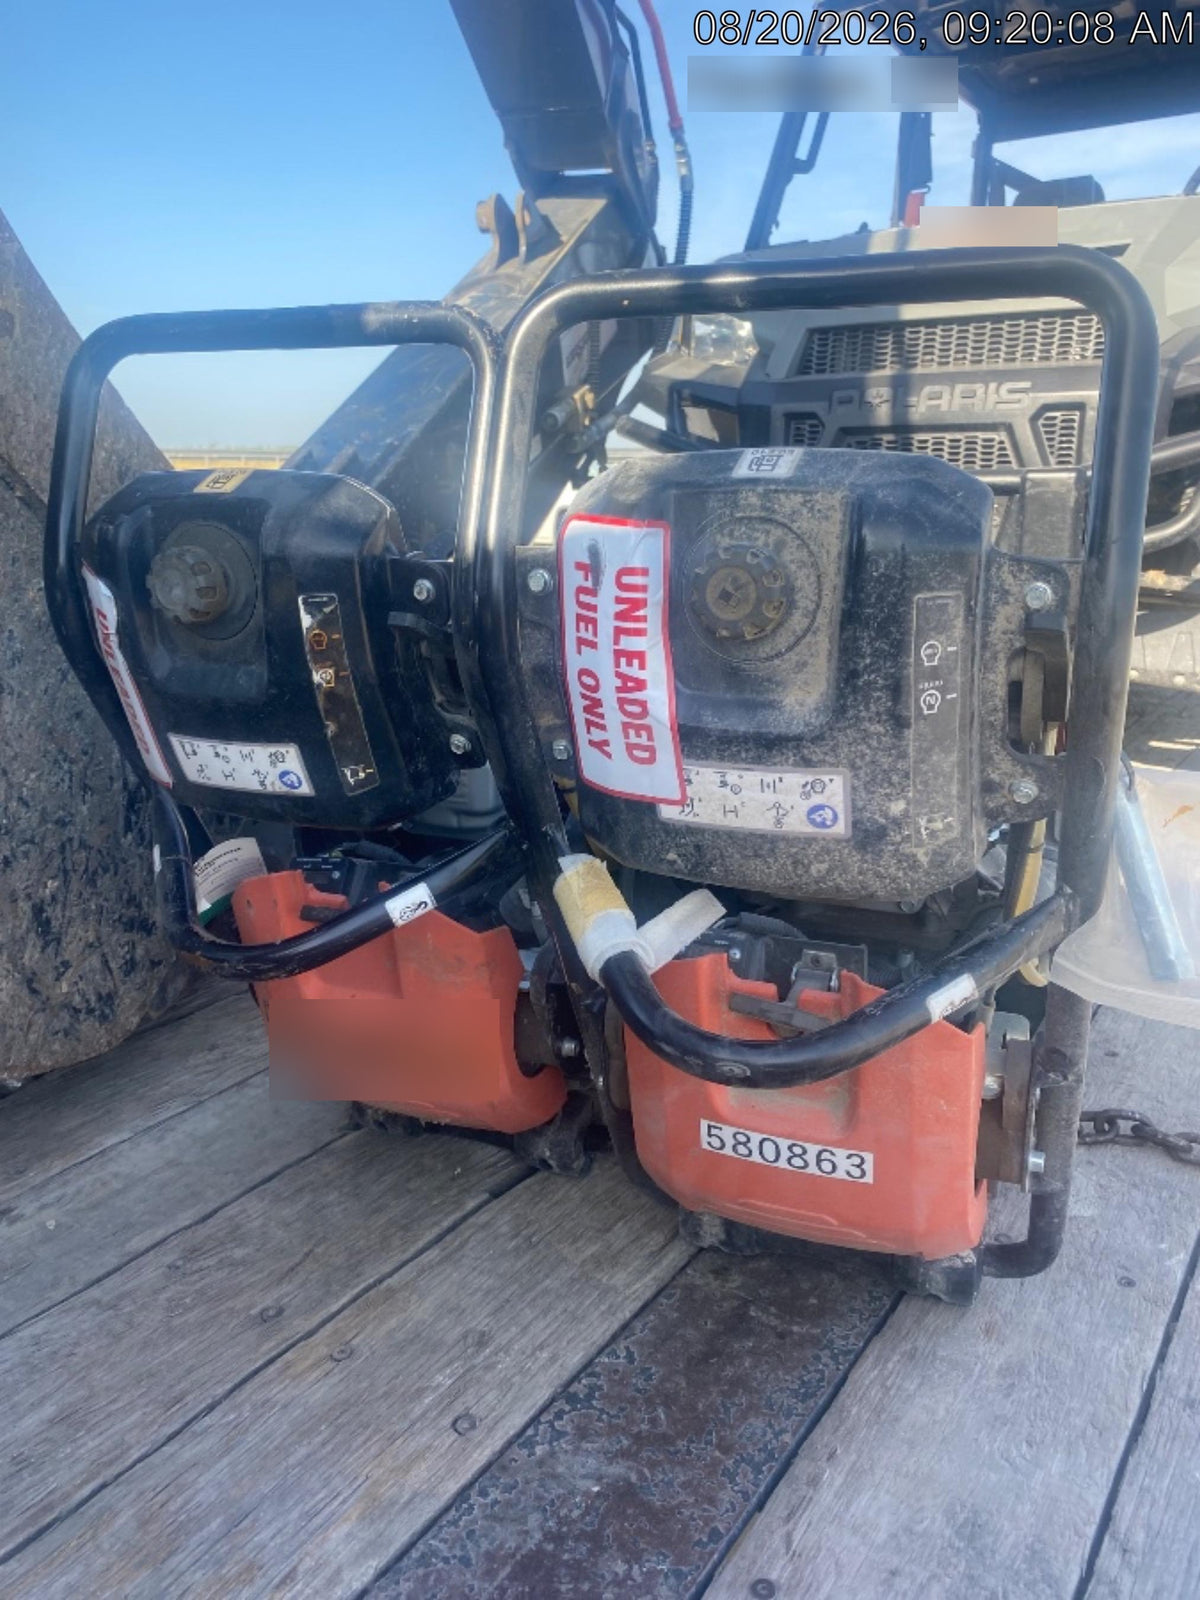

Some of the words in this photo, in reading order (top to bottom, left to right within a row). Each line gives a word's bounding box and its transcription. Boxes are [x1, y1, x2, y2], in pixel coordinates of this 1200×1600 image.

[829, 381, 1032, 413] POLARIS
[574, 560, 599, 656] FUEL
[613, 566, 657, 766] UNLEADED
[577, 667, 613, 761] ONLY
[706, 1123, 867, 1180] 580863
